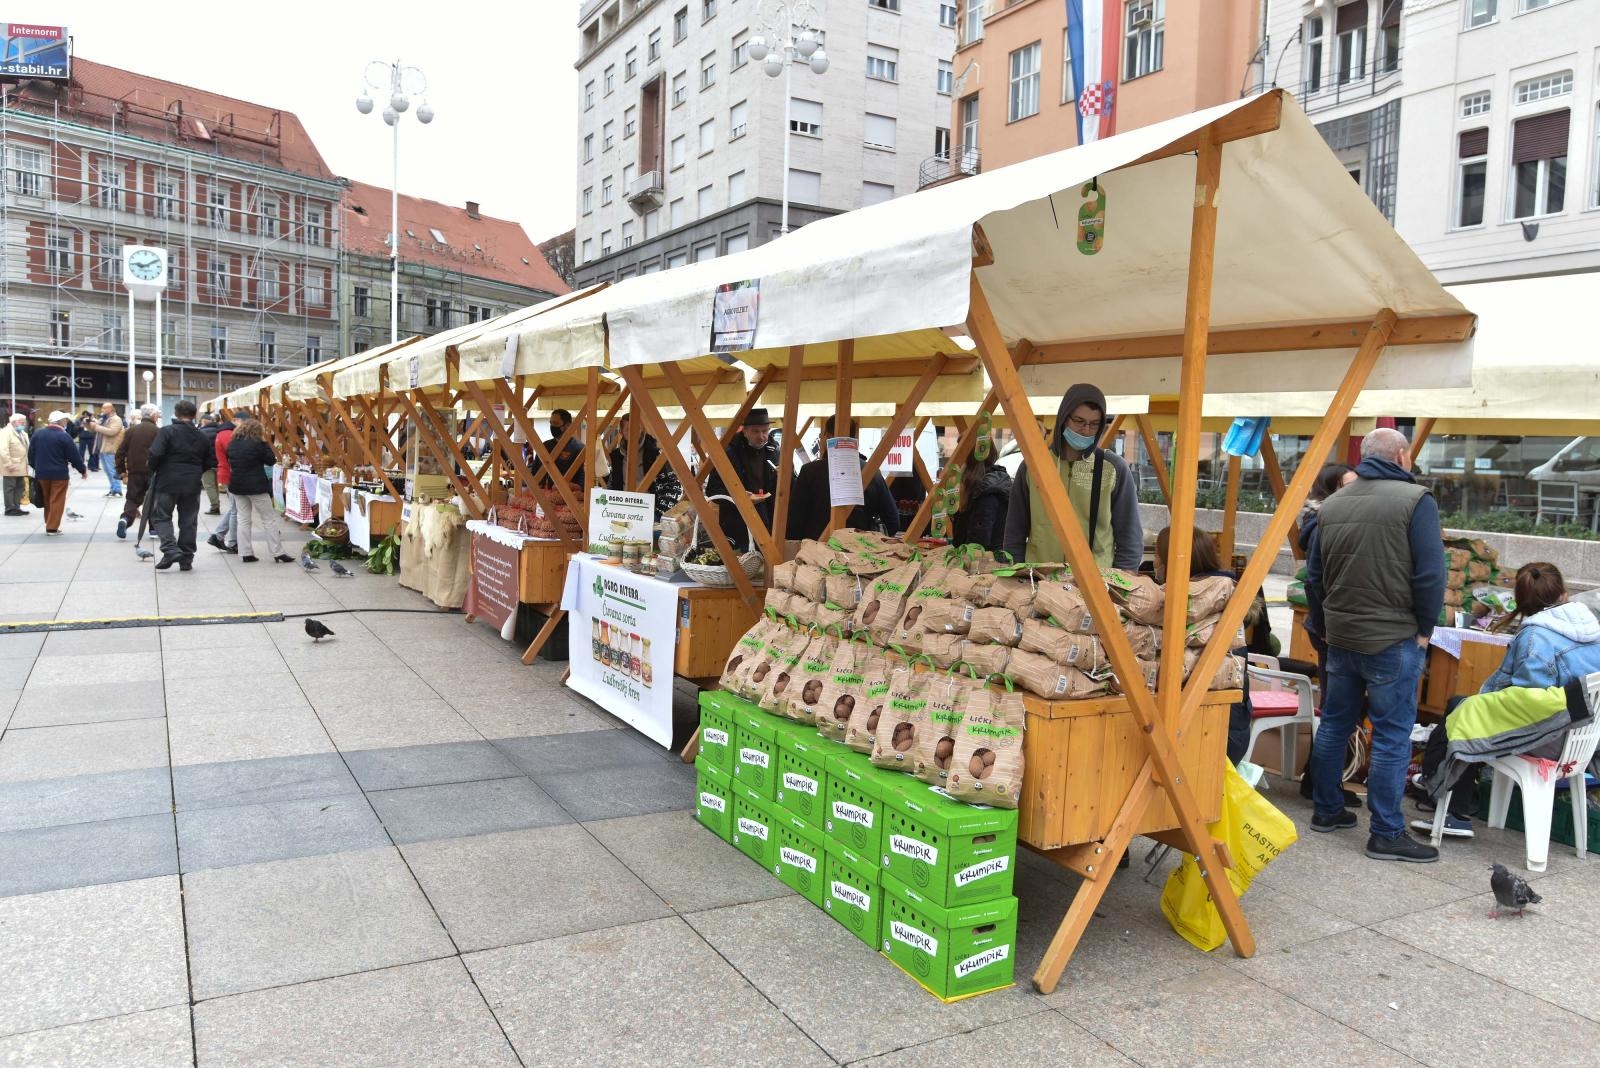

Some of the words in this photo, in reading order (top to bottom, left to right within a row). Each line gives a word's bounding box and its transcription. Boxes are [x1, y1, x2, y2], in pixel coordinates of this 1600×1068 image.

[12, 26, 58, 36] Internorm
[0, 64, 62, 76] -stabil.hr
[45, 374, 93, 390] ZAKS
[887, 453, 902, 466] VINO
